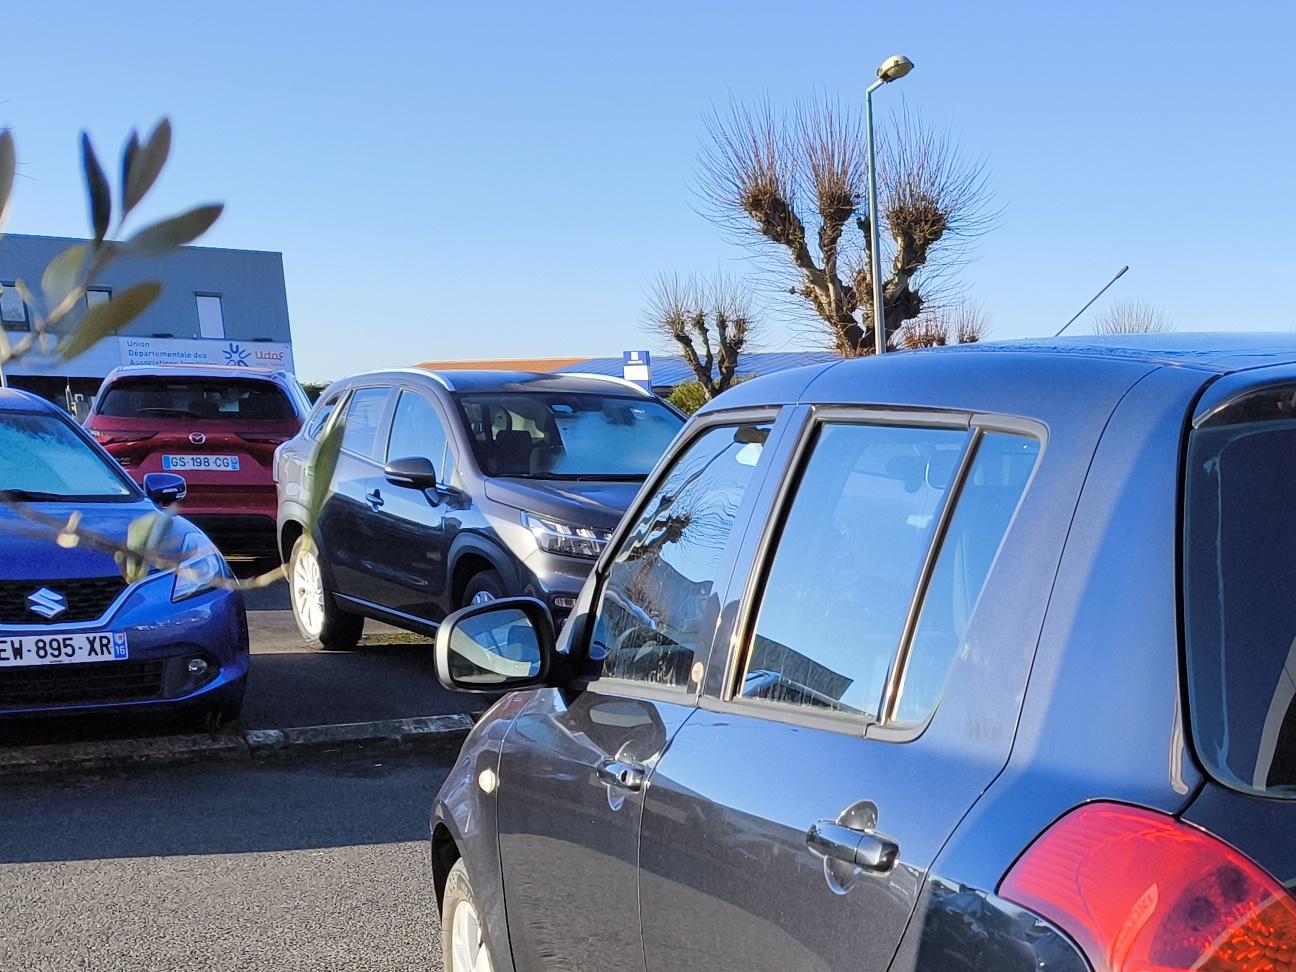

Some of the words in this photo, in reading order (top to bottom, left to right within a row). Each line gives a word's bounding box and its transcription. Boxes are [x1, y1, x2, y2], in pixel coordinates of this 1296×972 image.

[127, 340, 150, 348] Union
[128, 349, 192, 359] Départementale
[193, 351, 208, 359] des
[171, 457, 230, 468] GS-198-CG
[0, 635, 112, 661] EW-895-XR
[115, 646, 125, 655] 16
